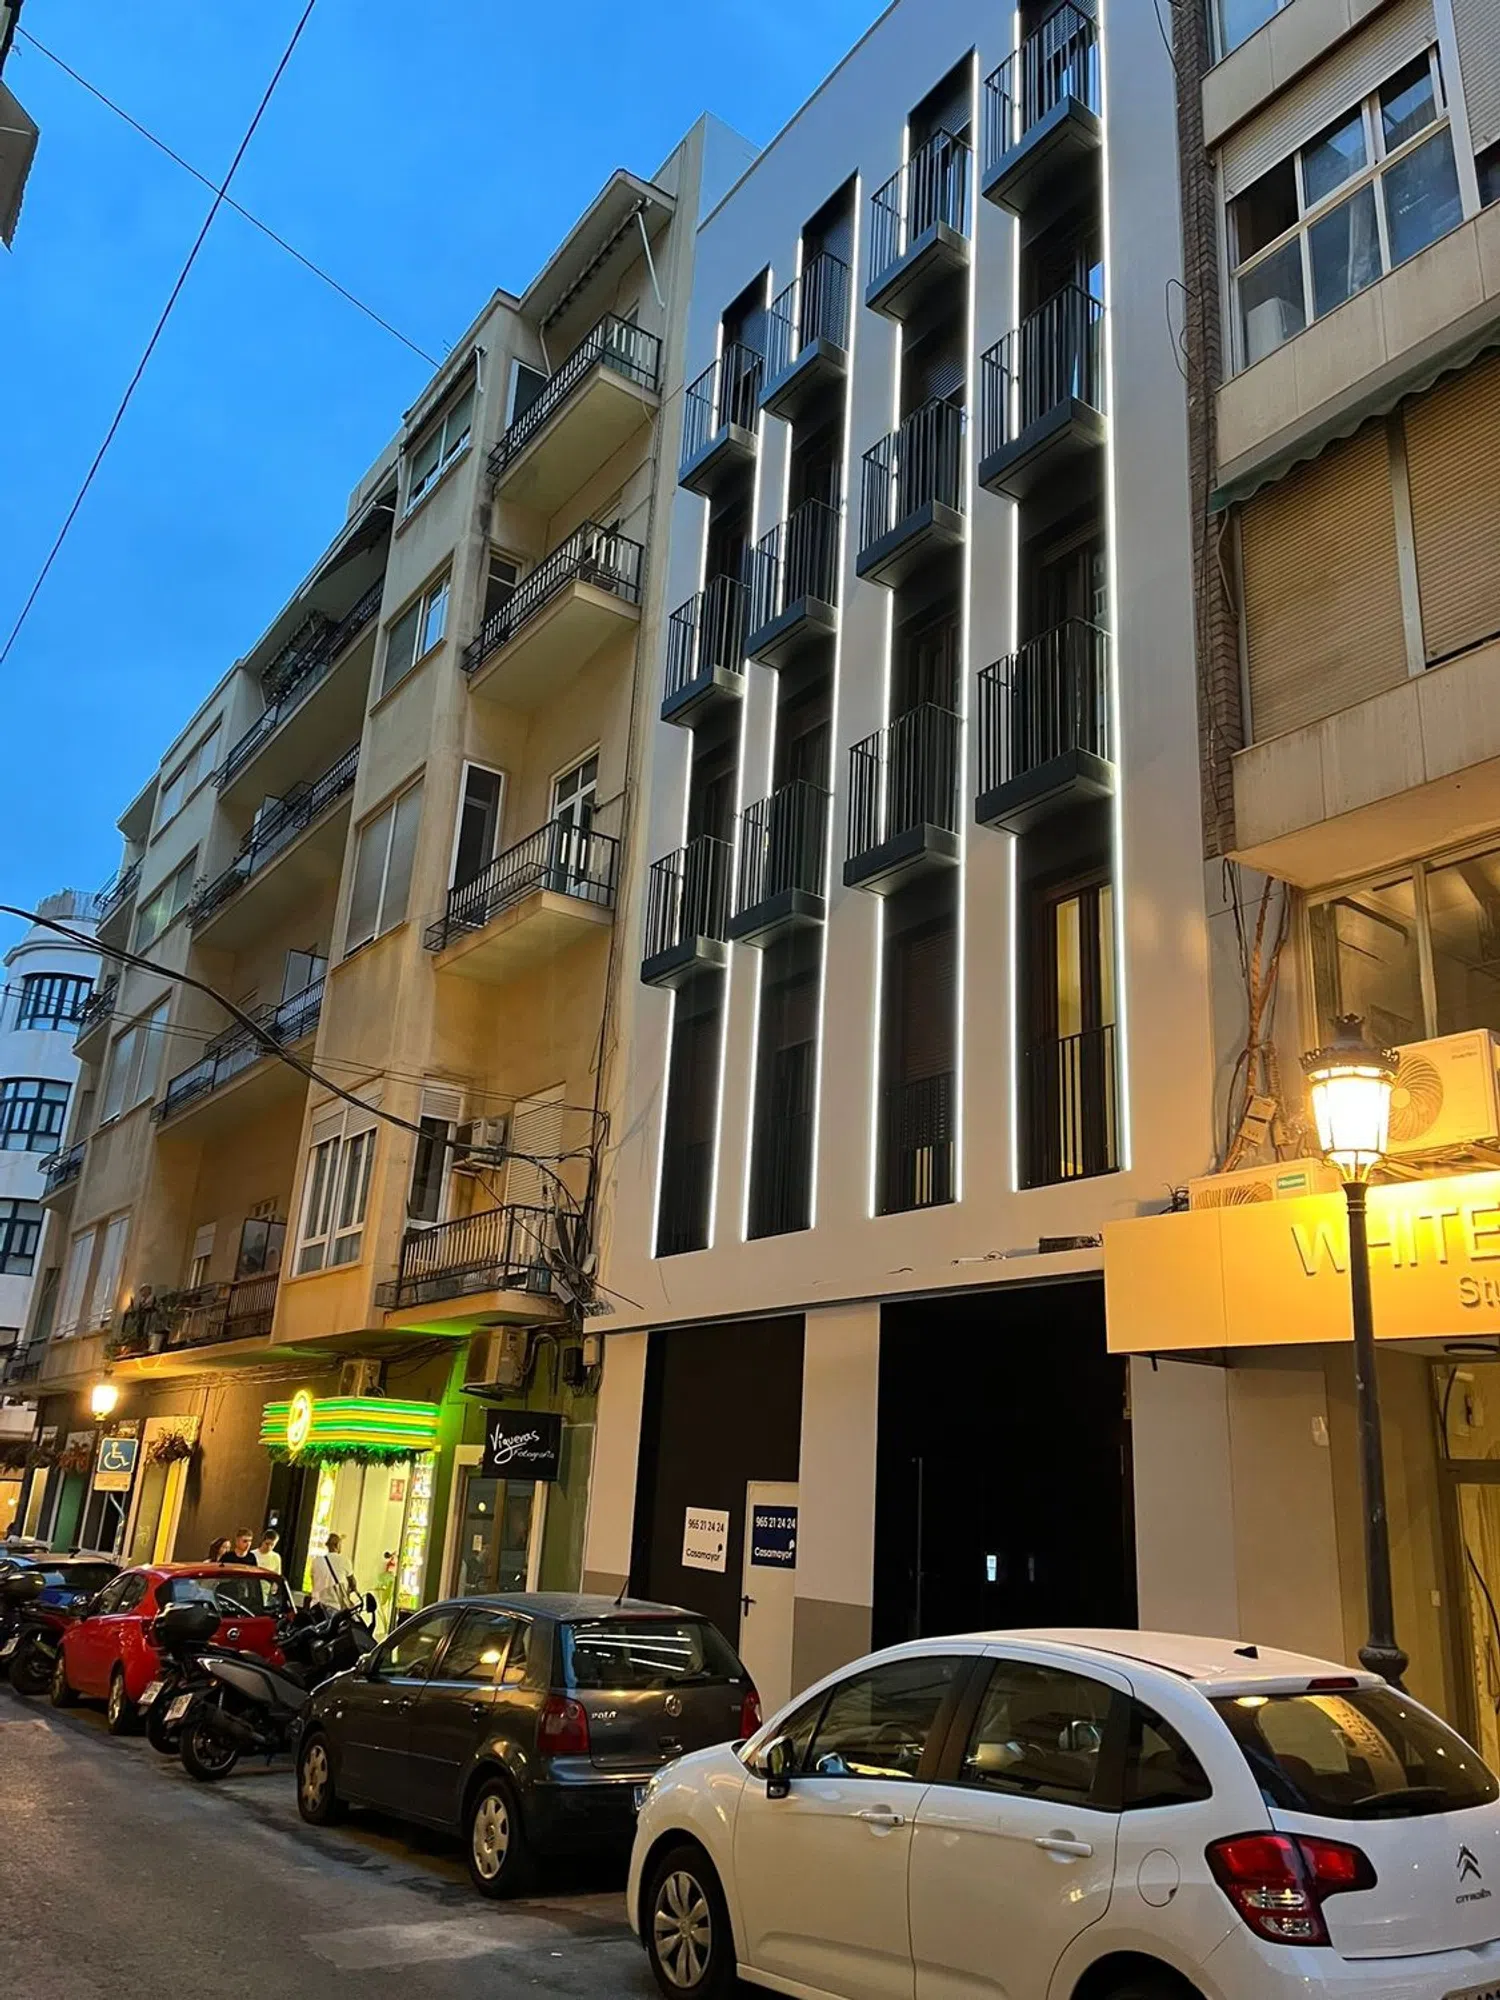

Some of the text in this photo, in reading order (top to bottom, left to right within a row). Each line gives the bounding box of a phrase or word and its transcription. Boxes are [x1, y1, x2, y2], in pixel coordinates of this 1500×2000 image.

[688, 1518, 724, 1532] 965 21 24 24
[756, 1516, 796, 1529] 965 21 24 24
[686, 1548, 720, 1562] Casamayor
[754, 1546, 793, 1560] Casamayor
